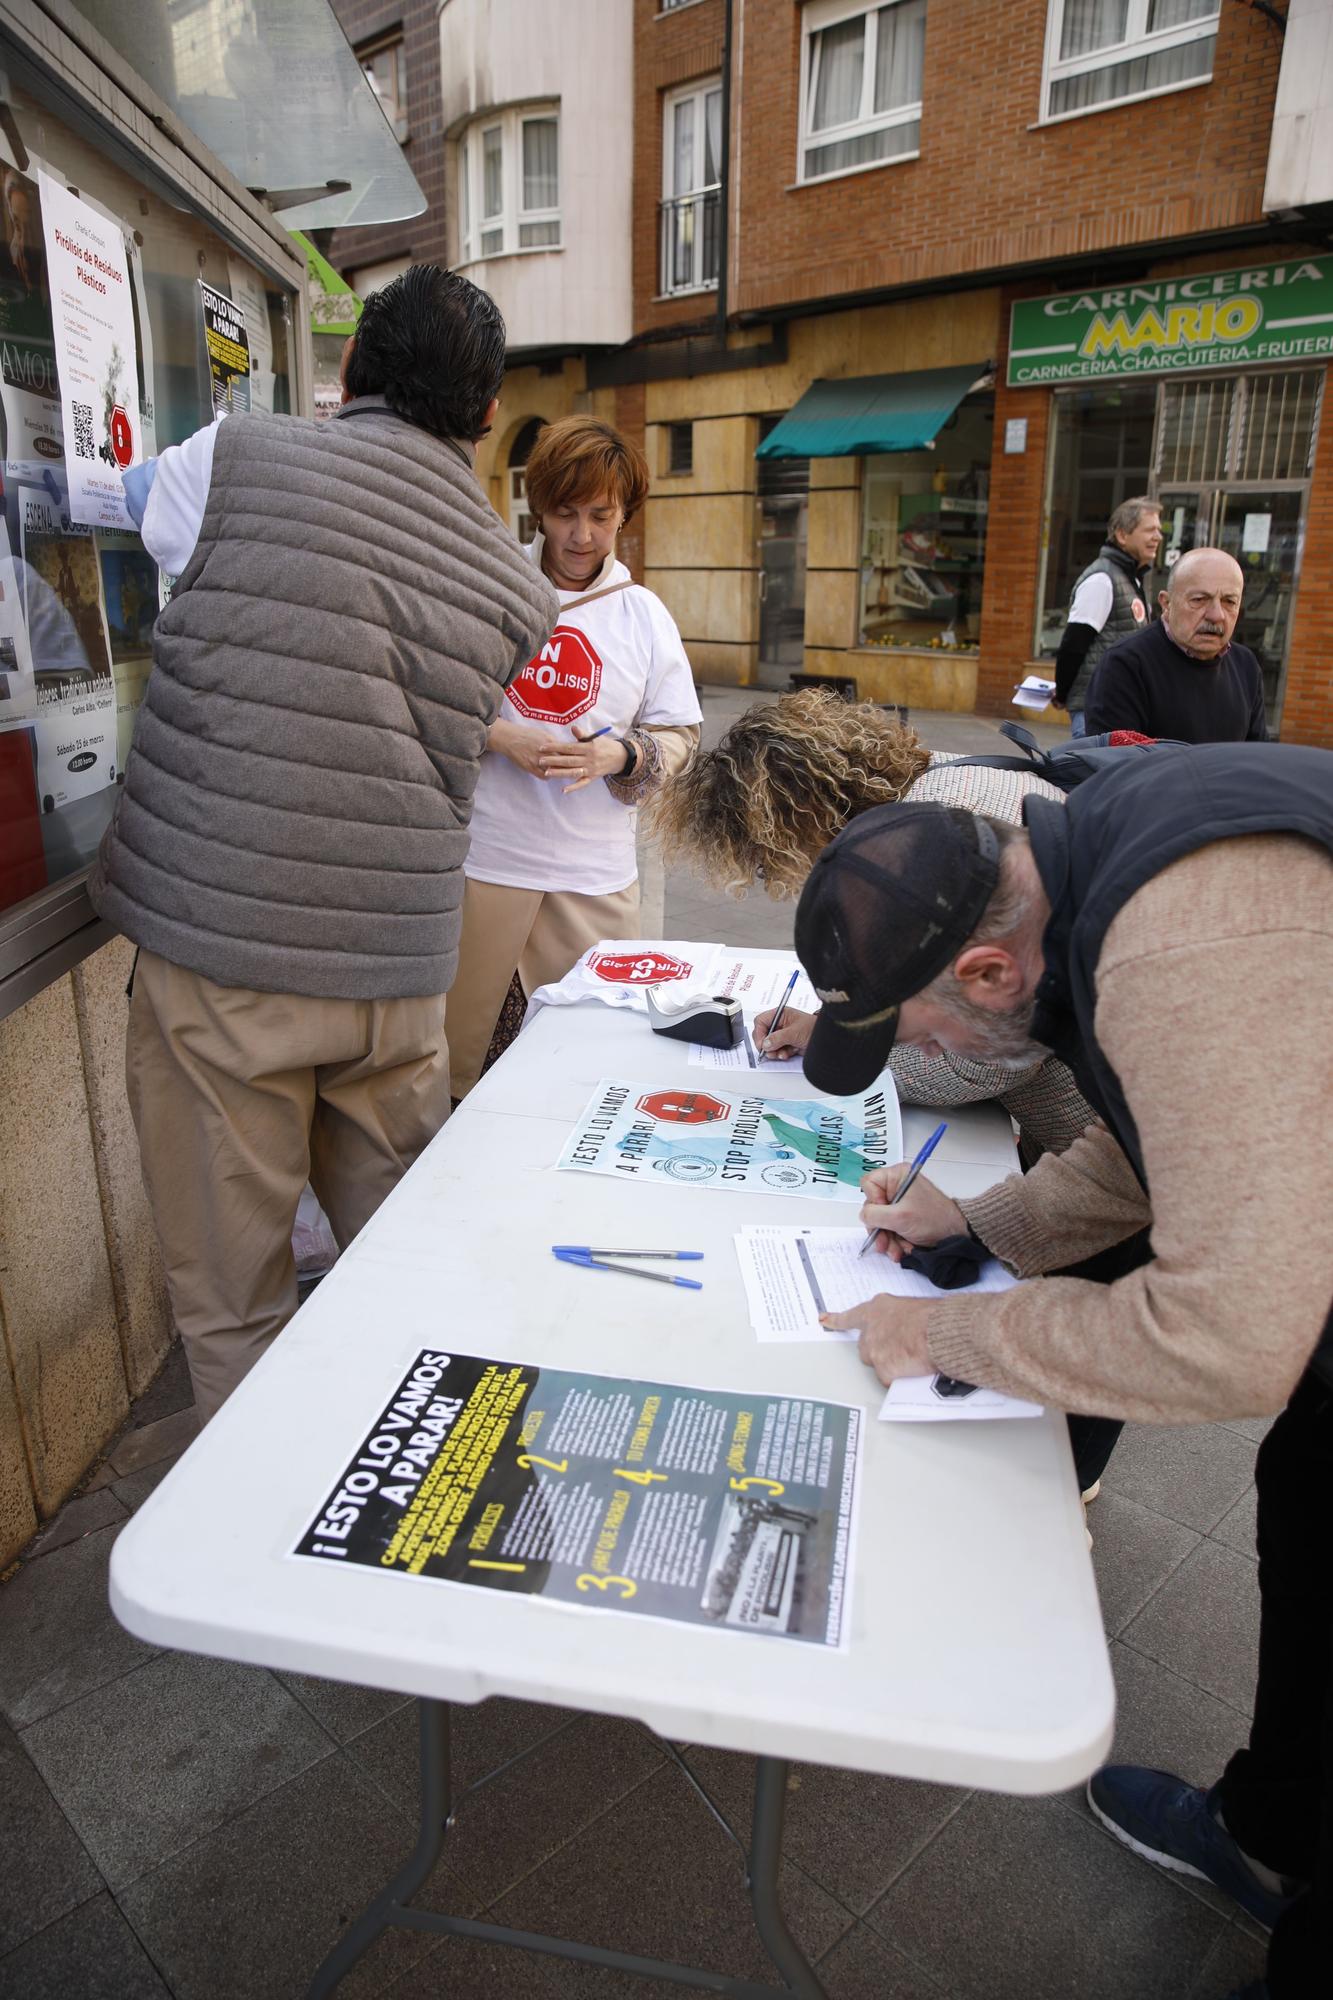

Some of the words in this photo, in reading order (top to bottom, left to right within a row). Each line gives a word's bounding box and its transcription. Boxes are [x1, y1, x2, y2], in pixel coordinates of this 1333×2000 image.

[55, 229, 82, 259] Pirólisis
[84, 249, 93, 266] de
[77, 266, 107, 295] Plásticos
[1043, 263, 1324, 316] CARNICERIA
[217, 299, 227, 318] LO
[1077, 293, 1263, 360] MARIO
[314, 401, 341, 410] MARZ
[544, 714, 569, 724] contra
[56, 742, 76, 757] Sábado
[76, 739, 82, 750] 25
[83, 738, 89, 747] de
[89, 735, 104, 746] marzo
[587, 1118, 613, 1130] LO
[609, 1086, 632, 1116] VAMOS
[863, 1092, 891, 1154] QUEMAN
[623, 1120, 657, 1160] PARAR!
[615, 1164, 639, 1173] A
[721, 1150, 751, 1180] STOP
[812, 1167, 839, 1184] TÚ
[488, 1381, 501, 1392] EN
[494, 1372, 506, 1381] EL
[380, 1352, 451, 1433] VAMOS
[488, 1395, 507, 1415] 11:00
[482, 1415, 497, 1427] DE
[358, 1432, 404, 1468] LO
[390, 1394, 462, 1480] PARAR!
[465, 1427, 491, 1460] MARZO
[377, 1510, 418, 1565] CAMPAÑA
[408, 1497, 426, 1512] DE
[417, 1450, 451, 1498] RECOGIDA
[442, 1438, 458, 1451] DE
[466, 1375, 492, 1408] CONTRA
[484, 1365, 497, 1375] LA
[445, 1437, 473, 1472] PLANTA
[459, 1459, 475, 1473] DE
[514, 1452, 568, 1475] 2
[431, 1522, 459, 1556] ZONA
[465, 1453, 493, 1490] ATENEO
[483, 1417, 510, 1454] OBRERO
[433, 1473, 454, 1495] UNA
[451, 1472, 469, 1487] 26
[612, 1464, 668, 1488] 4
[729, 1473, 784, 1497] 5
[375, 1480, 414, 1506] A
[425, 1494, 443, 1509] DE
[426, 1486, 461, 1537] DOMINGO
[837, 1516, 849, 1529] DE
[398, 1508, 435, 1562] APERTURA
[575, 1569, 637, 1599] 3
